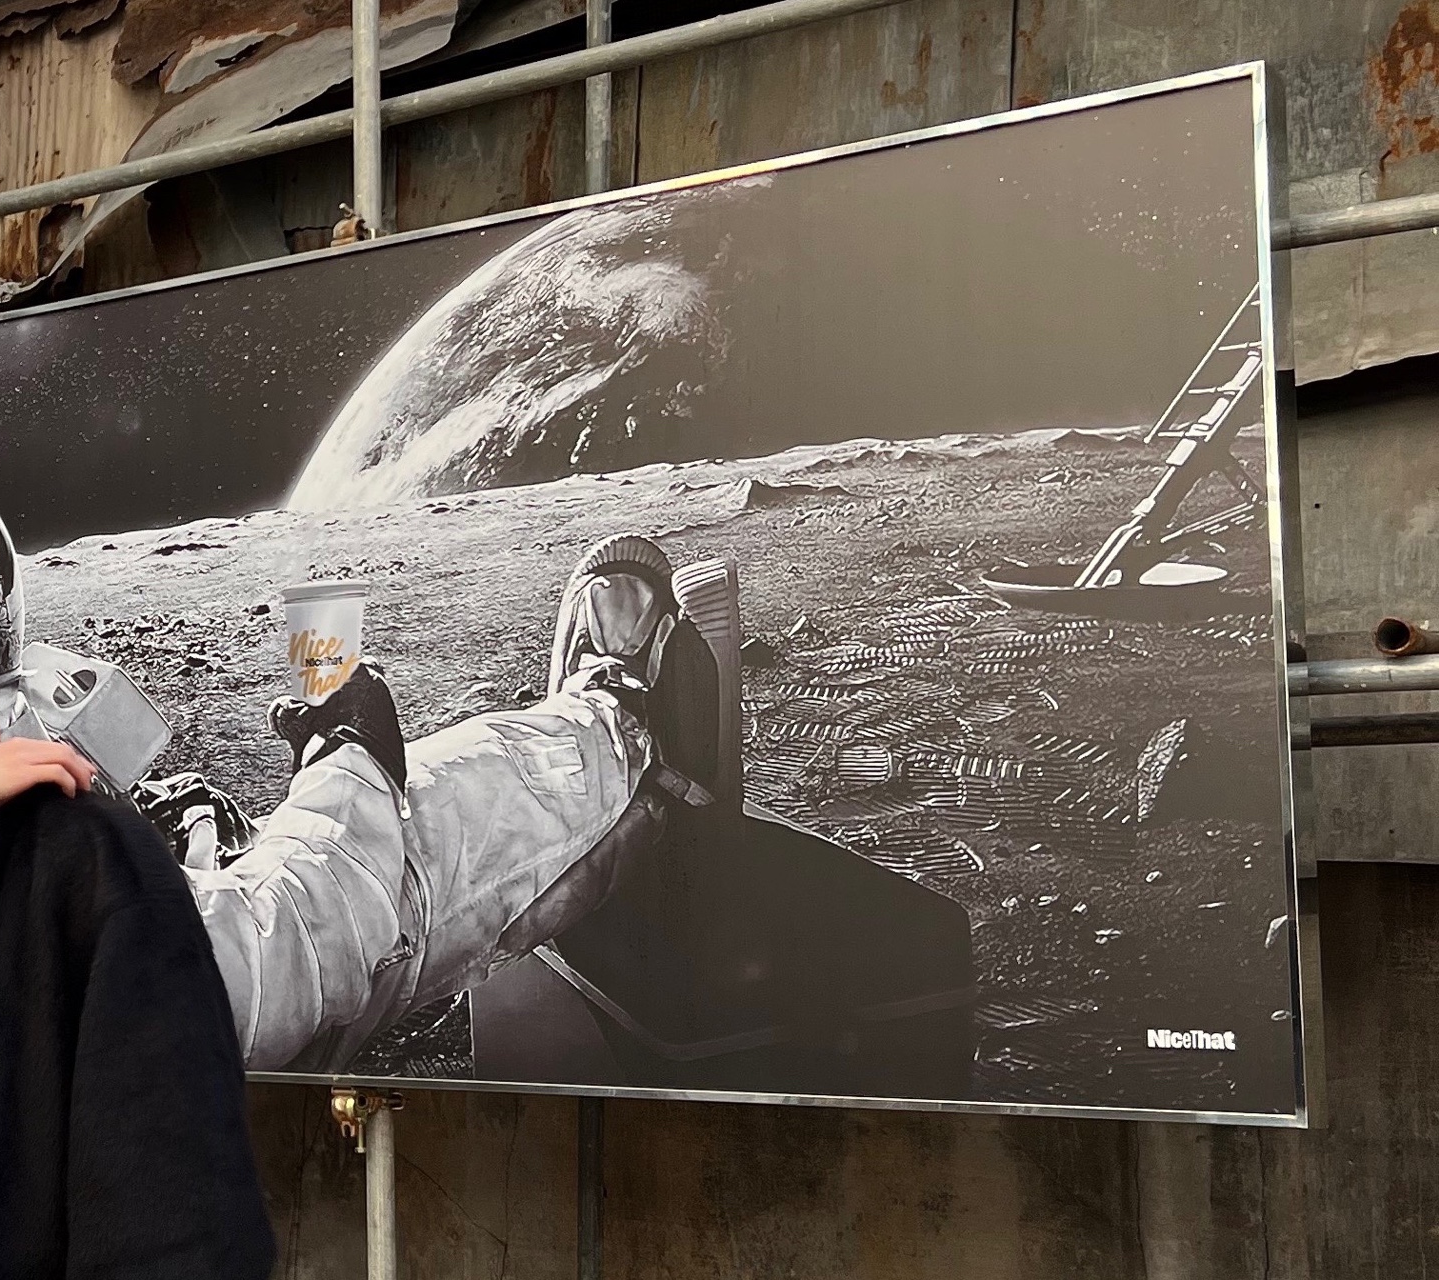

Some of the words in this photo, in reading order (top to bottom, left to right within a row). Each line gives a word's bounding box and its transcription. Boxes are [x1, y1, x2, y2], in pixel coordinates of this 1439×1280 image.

[288, 628, 345, 668] Nice
[297, 652, 360, 698] That
[1146, 1029, 1237, 1051] NiceThat
